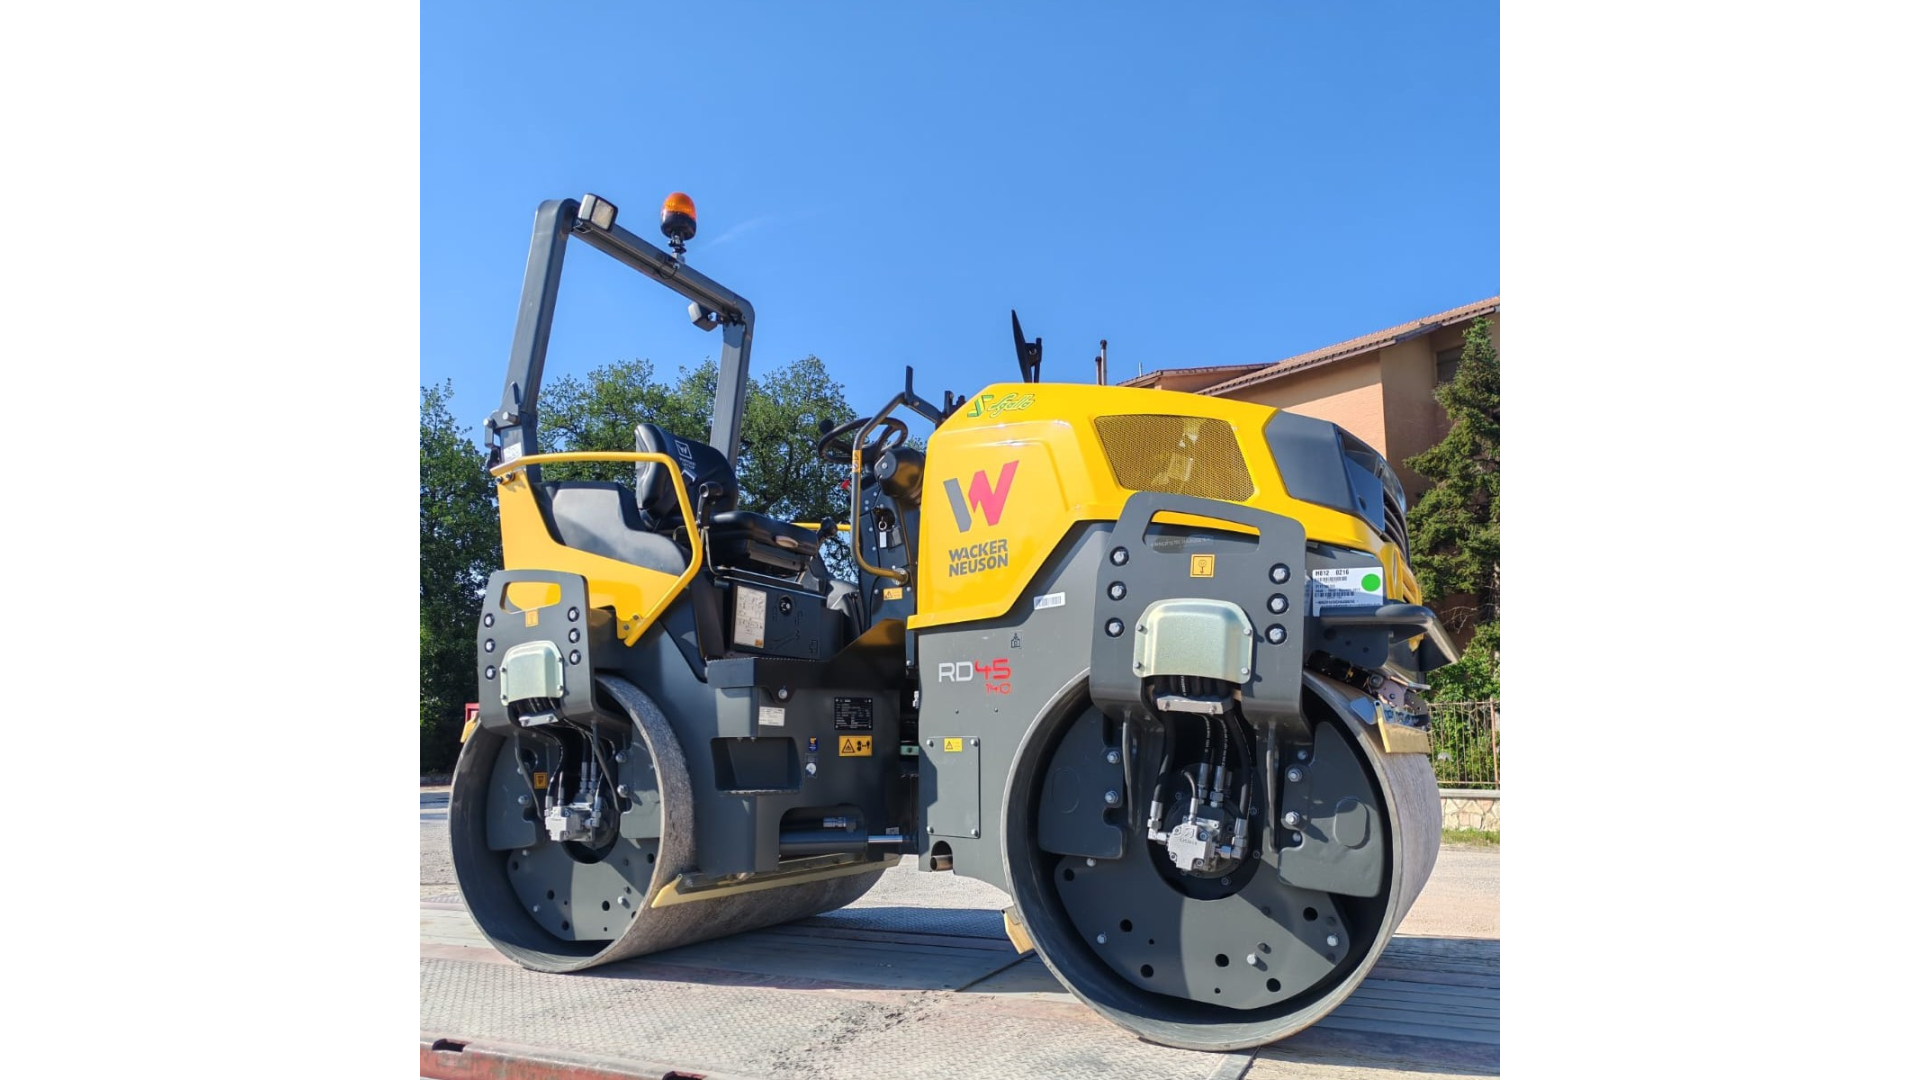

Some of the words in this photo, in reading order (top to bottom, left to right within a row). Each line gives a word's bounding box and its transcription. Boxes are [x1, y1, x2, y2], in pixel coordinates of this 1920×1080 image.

[948, 539, 1008, 562] WACKER
[948, 553, 1009, 577] NEUSON
[938, 658, 1011, 682] RD45
